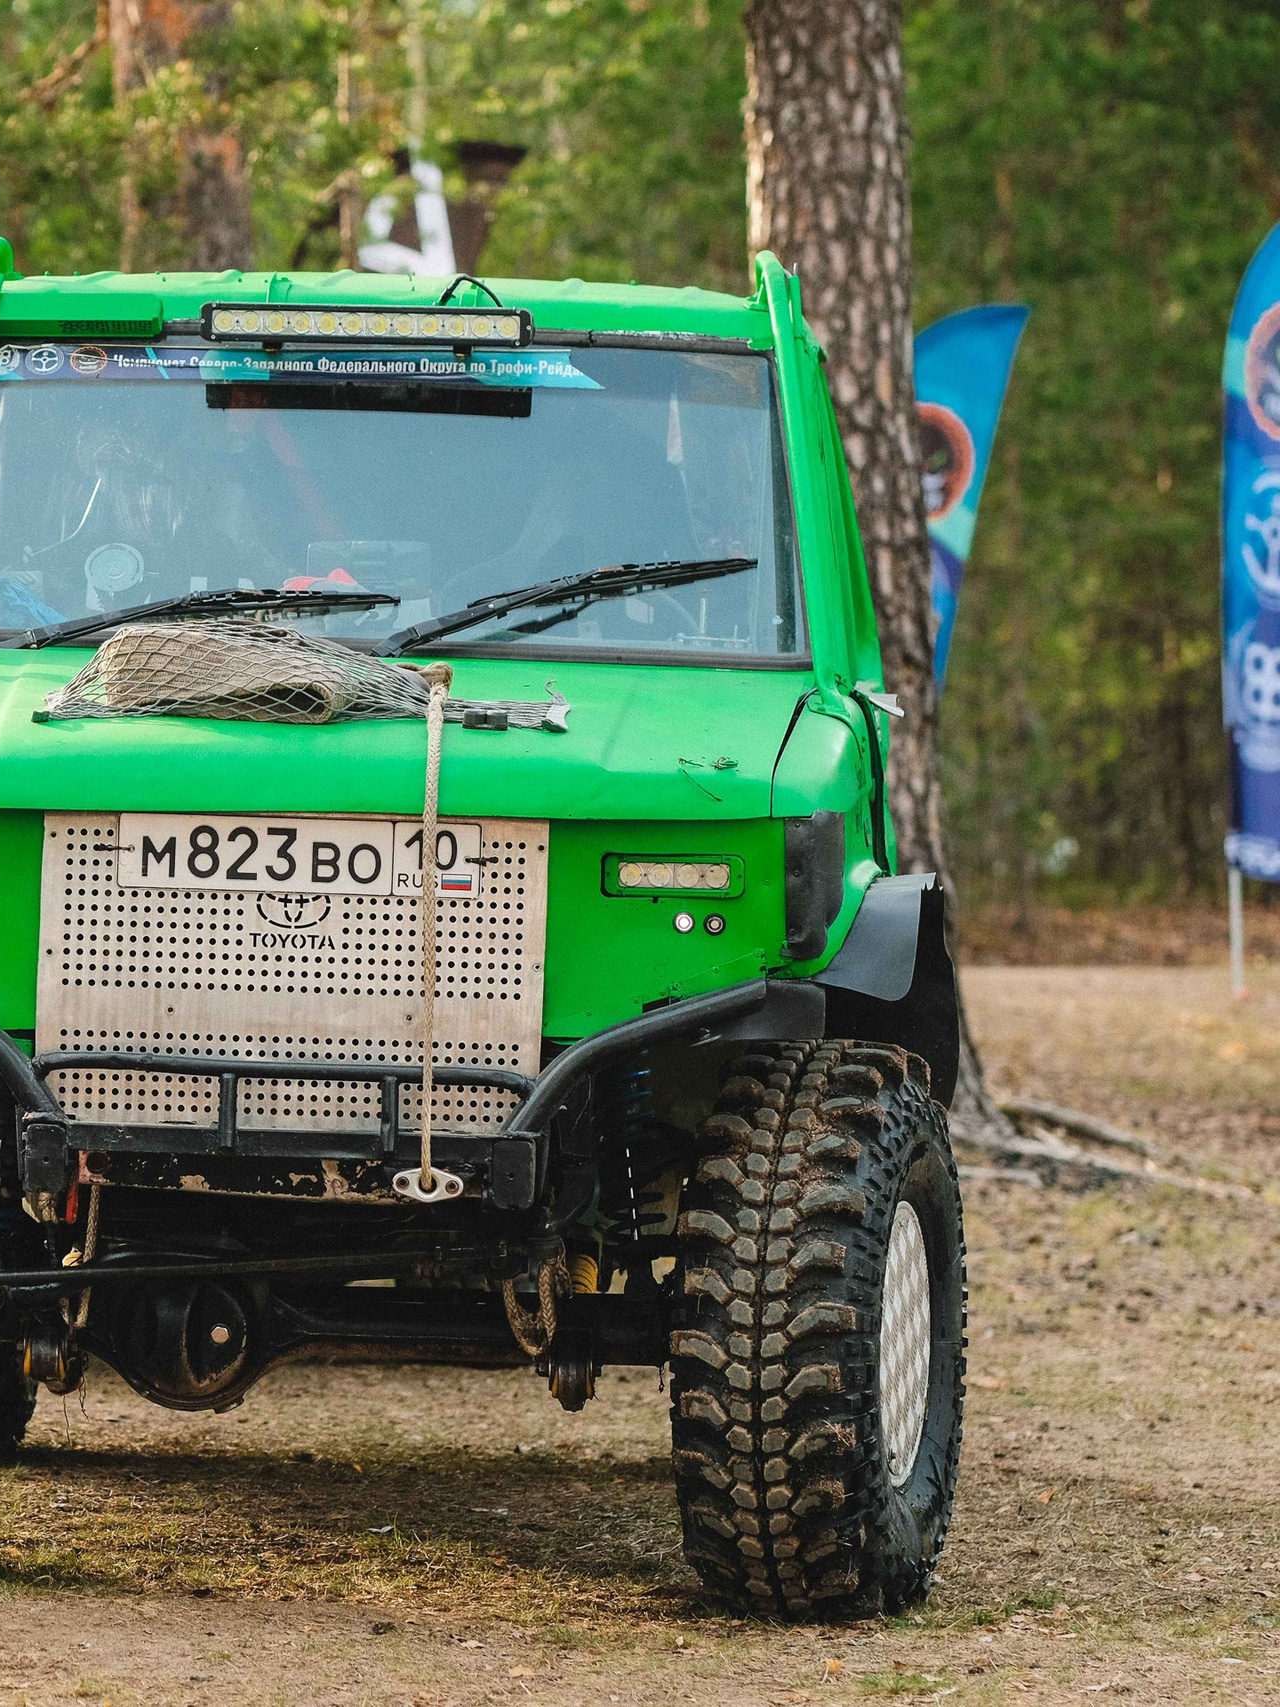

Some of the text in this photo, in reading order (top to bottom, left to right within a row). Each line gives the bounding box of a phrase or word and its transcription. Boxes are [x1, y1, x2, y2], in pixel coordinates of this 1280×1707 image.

[317, 356, 416, 374] Федерального
[420, 357, 466, 375] Округа
[470, 360, 486, 373] по
[490, 359, 584, 378] Трофи-Рейда
[404, 829, 458, 871] 10
[249, 932, 336, 951] TOYOTA
